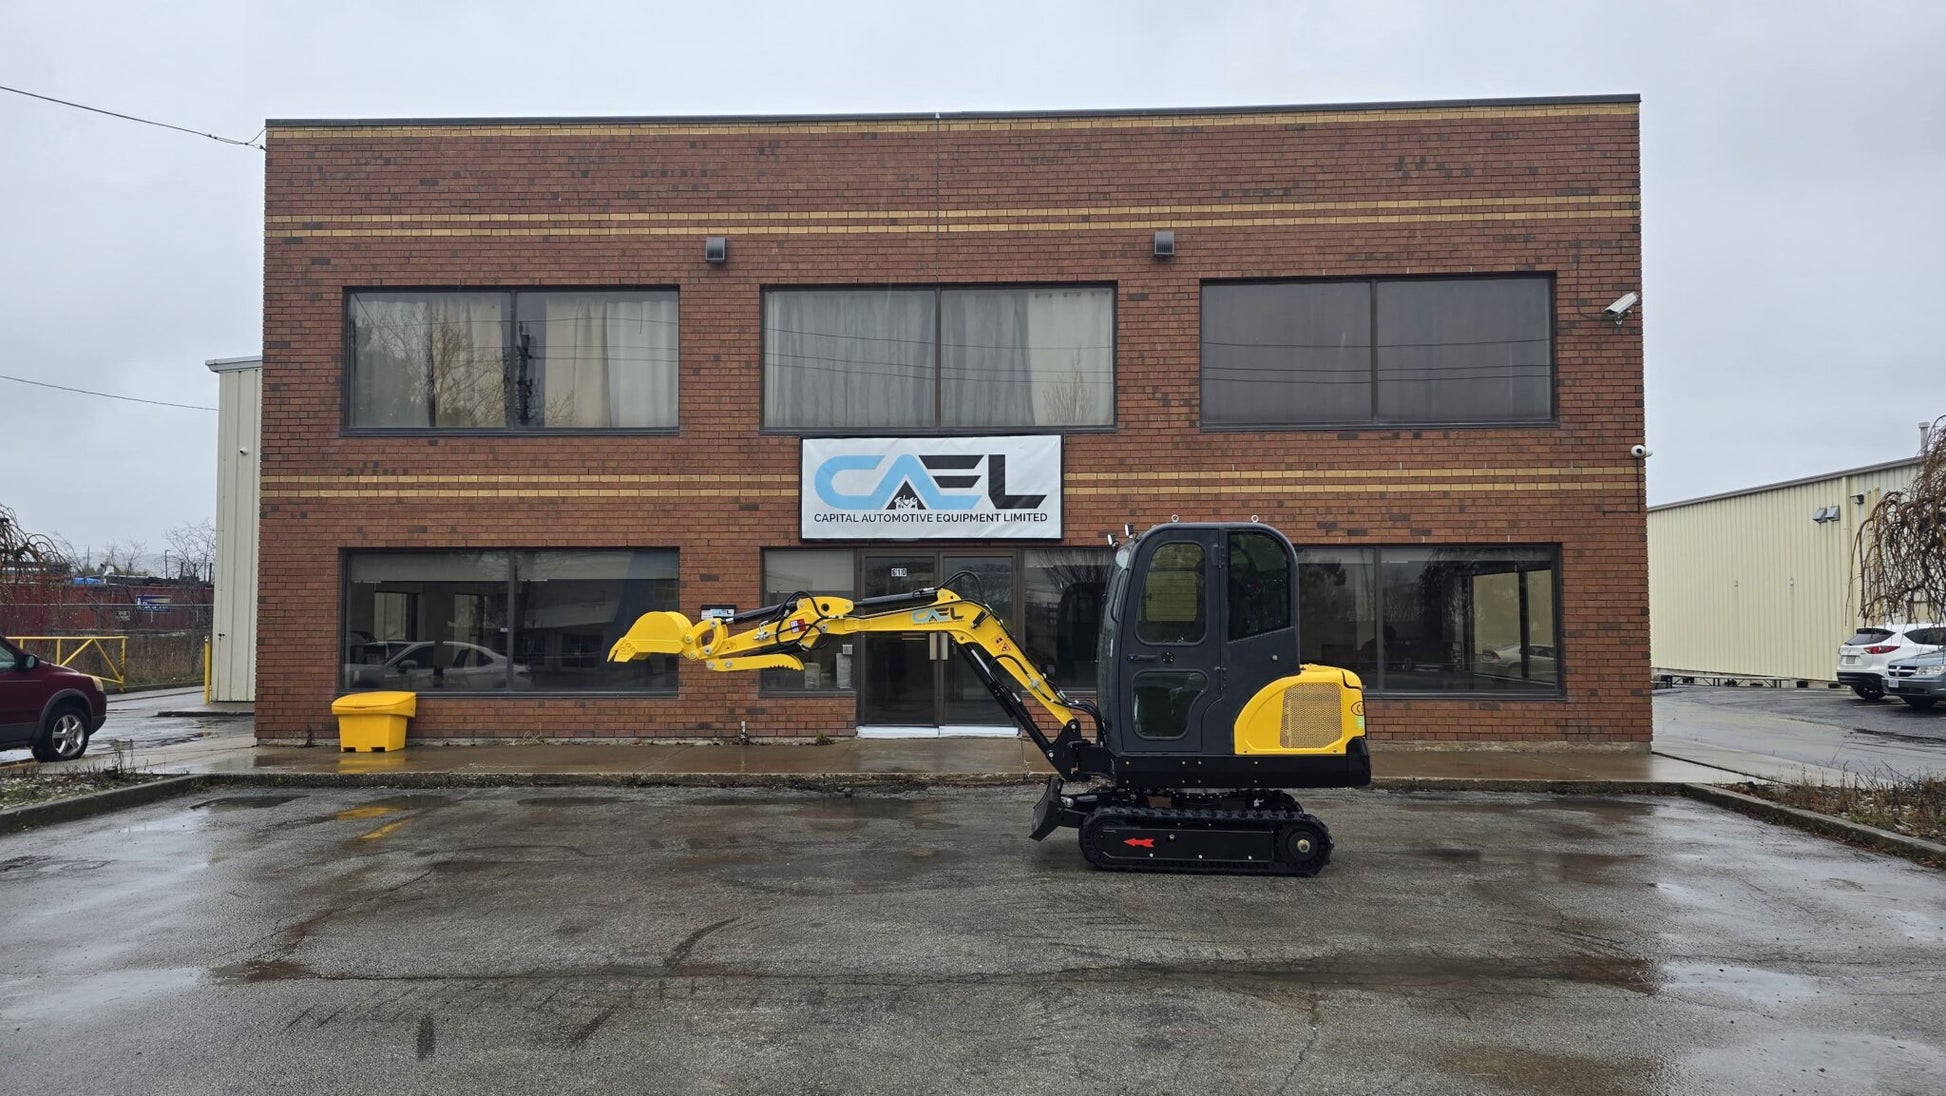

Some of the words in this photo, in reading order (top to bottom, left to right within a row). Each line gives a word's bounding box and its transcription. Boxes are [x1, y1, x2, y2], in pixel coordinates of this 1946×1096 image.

[814, 454, 1048, 510] CAEL
[814, 513, 859, 523] CAPITAL
[861, 513, 933, 523] AUTOMOTIVE
[936, 513, 1001, 522] EQUIPMENT
[1003, 512, 1048, 522] LIMITED
[912, 607, 964, 622] CAEL
